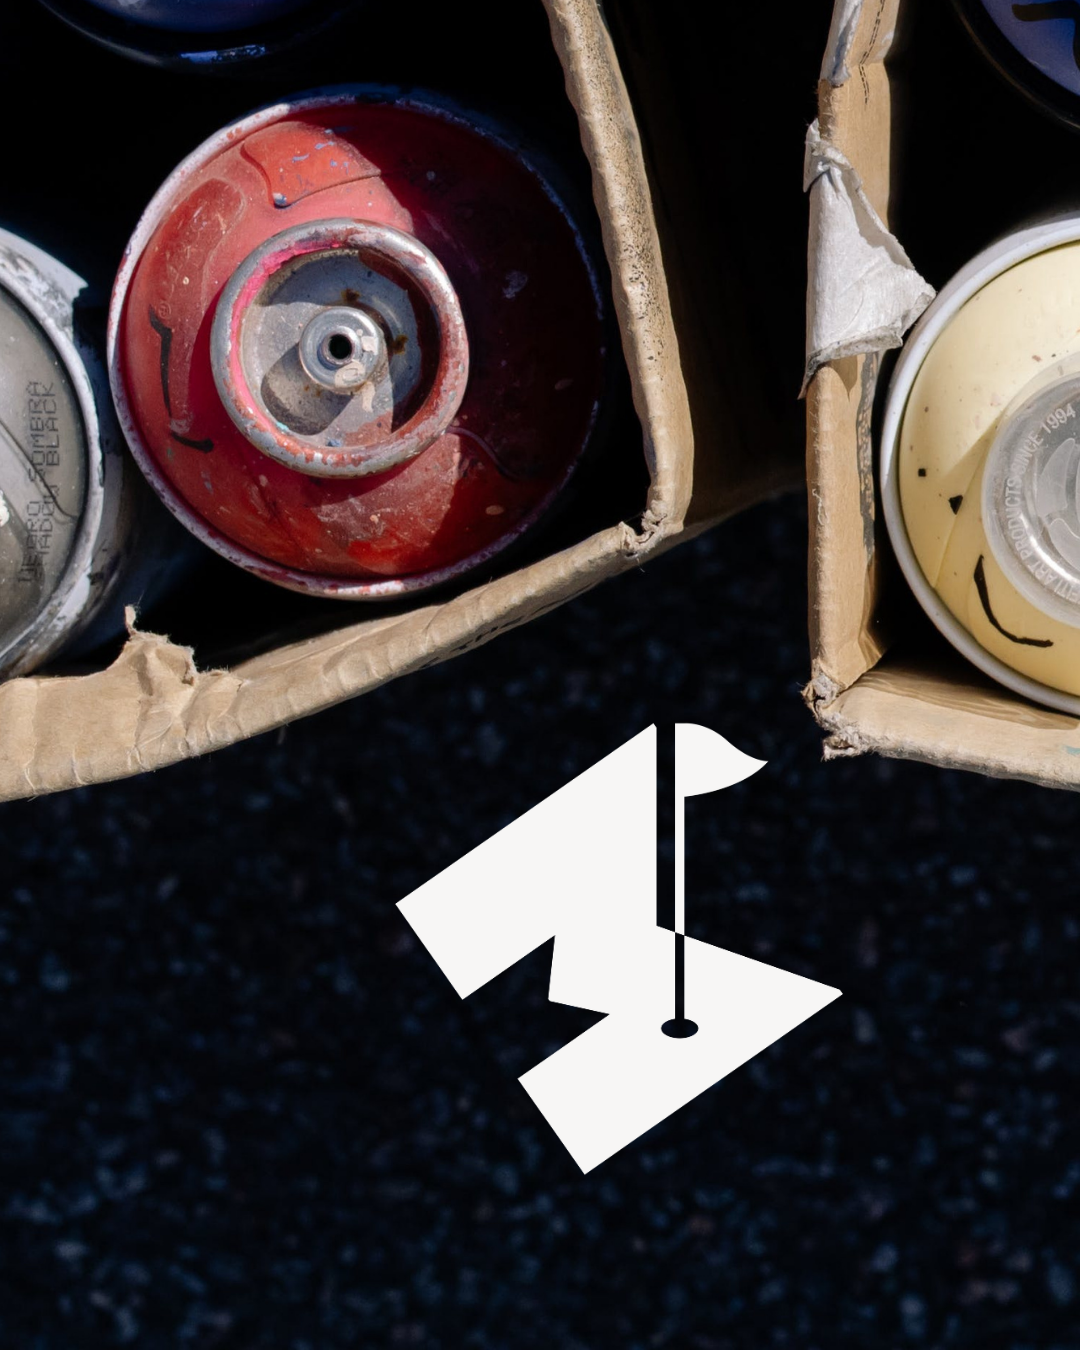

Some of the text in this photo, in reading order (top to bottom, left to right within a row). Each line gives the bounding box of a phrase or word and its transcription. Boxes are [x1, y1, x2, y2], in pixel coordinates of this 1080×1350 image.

[43, 381, 60, 467] BLACK
[1040, 403, 1077, 434] 1994
[1016, 430, 1045, 476] SINCE
[1004, 477, 1036, 561] PRODUCTS
